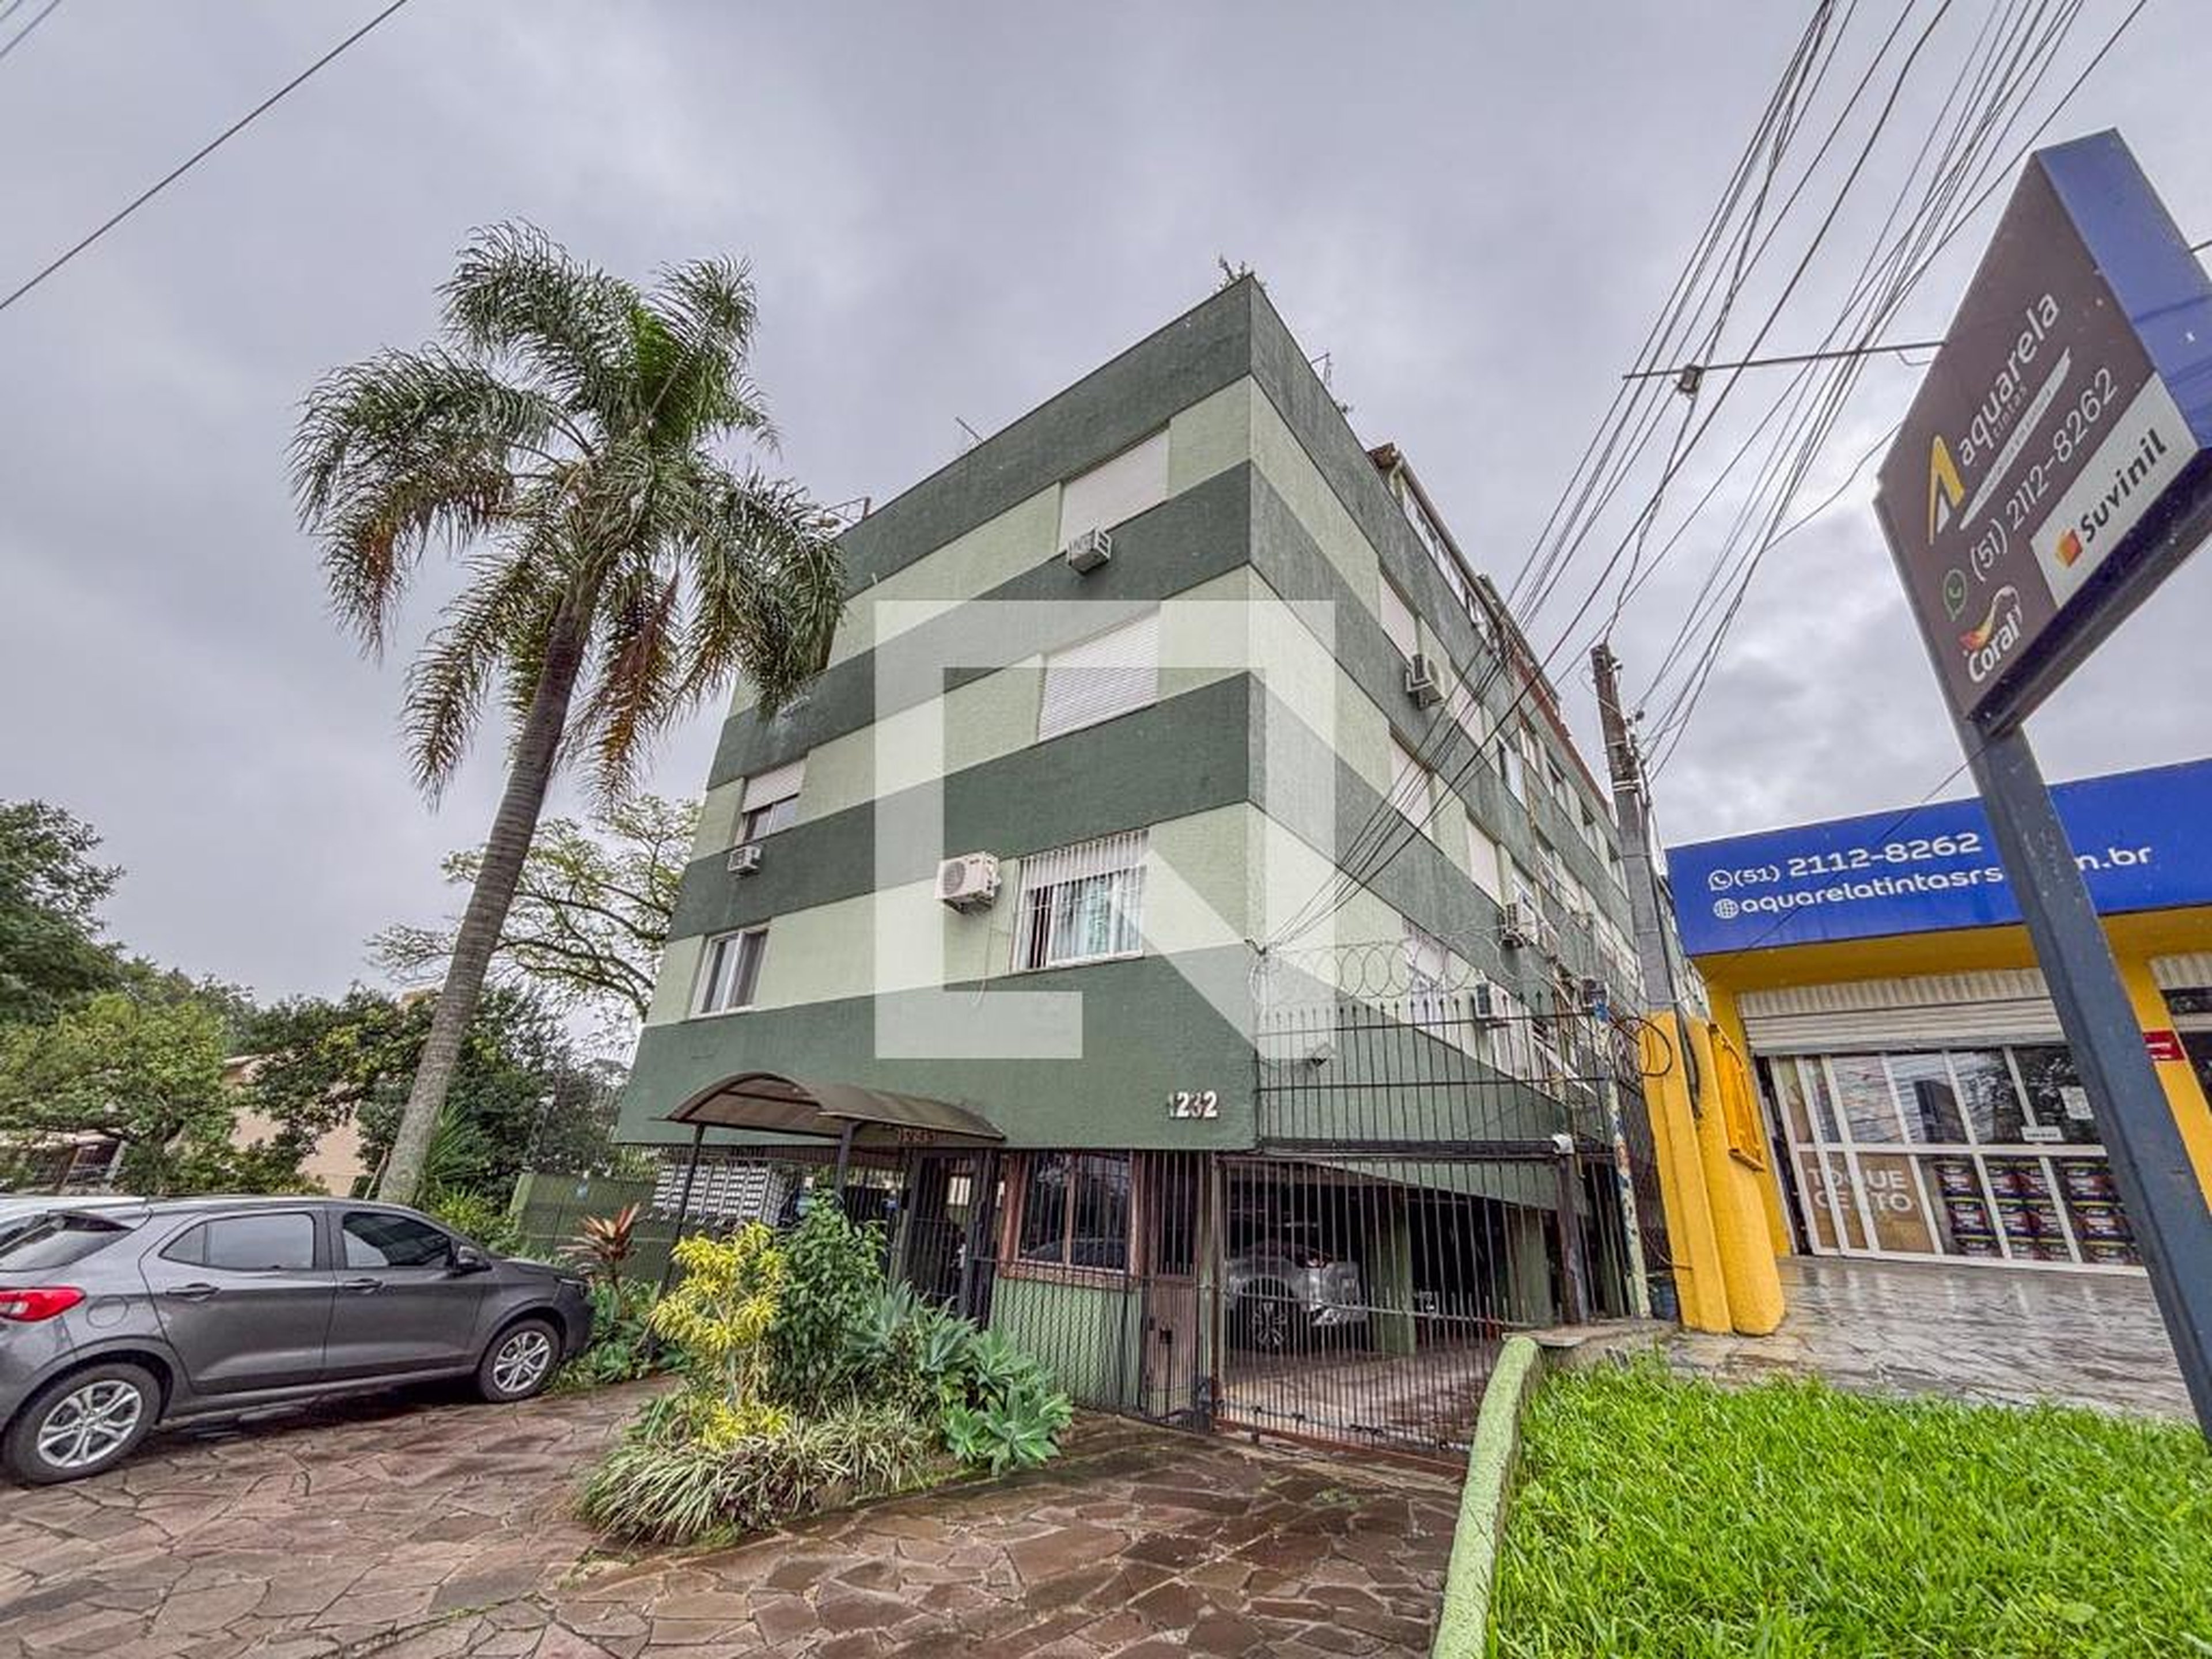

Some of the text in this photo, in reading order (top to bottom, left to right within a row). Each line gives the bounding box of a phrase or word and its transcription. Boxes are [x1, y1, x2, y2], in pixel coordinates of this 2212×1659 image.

[1960, 294, 2059, 465] aquarela
[1971, 518, 2008, 582] (51)
[2006, 368, 2118, 531] 2112-8262
[2081, 427, 2167, 543] Suvinil
[1968, 612, 2021, 682] Coral
[1734, 832, 1982, 887] (51) 2112-8262
[1167, 1089, 1218, 1118] 1232
[1807, 1168, 1907, 1189] TOUE
[1815, 1190, 1912, 1212] CETO
